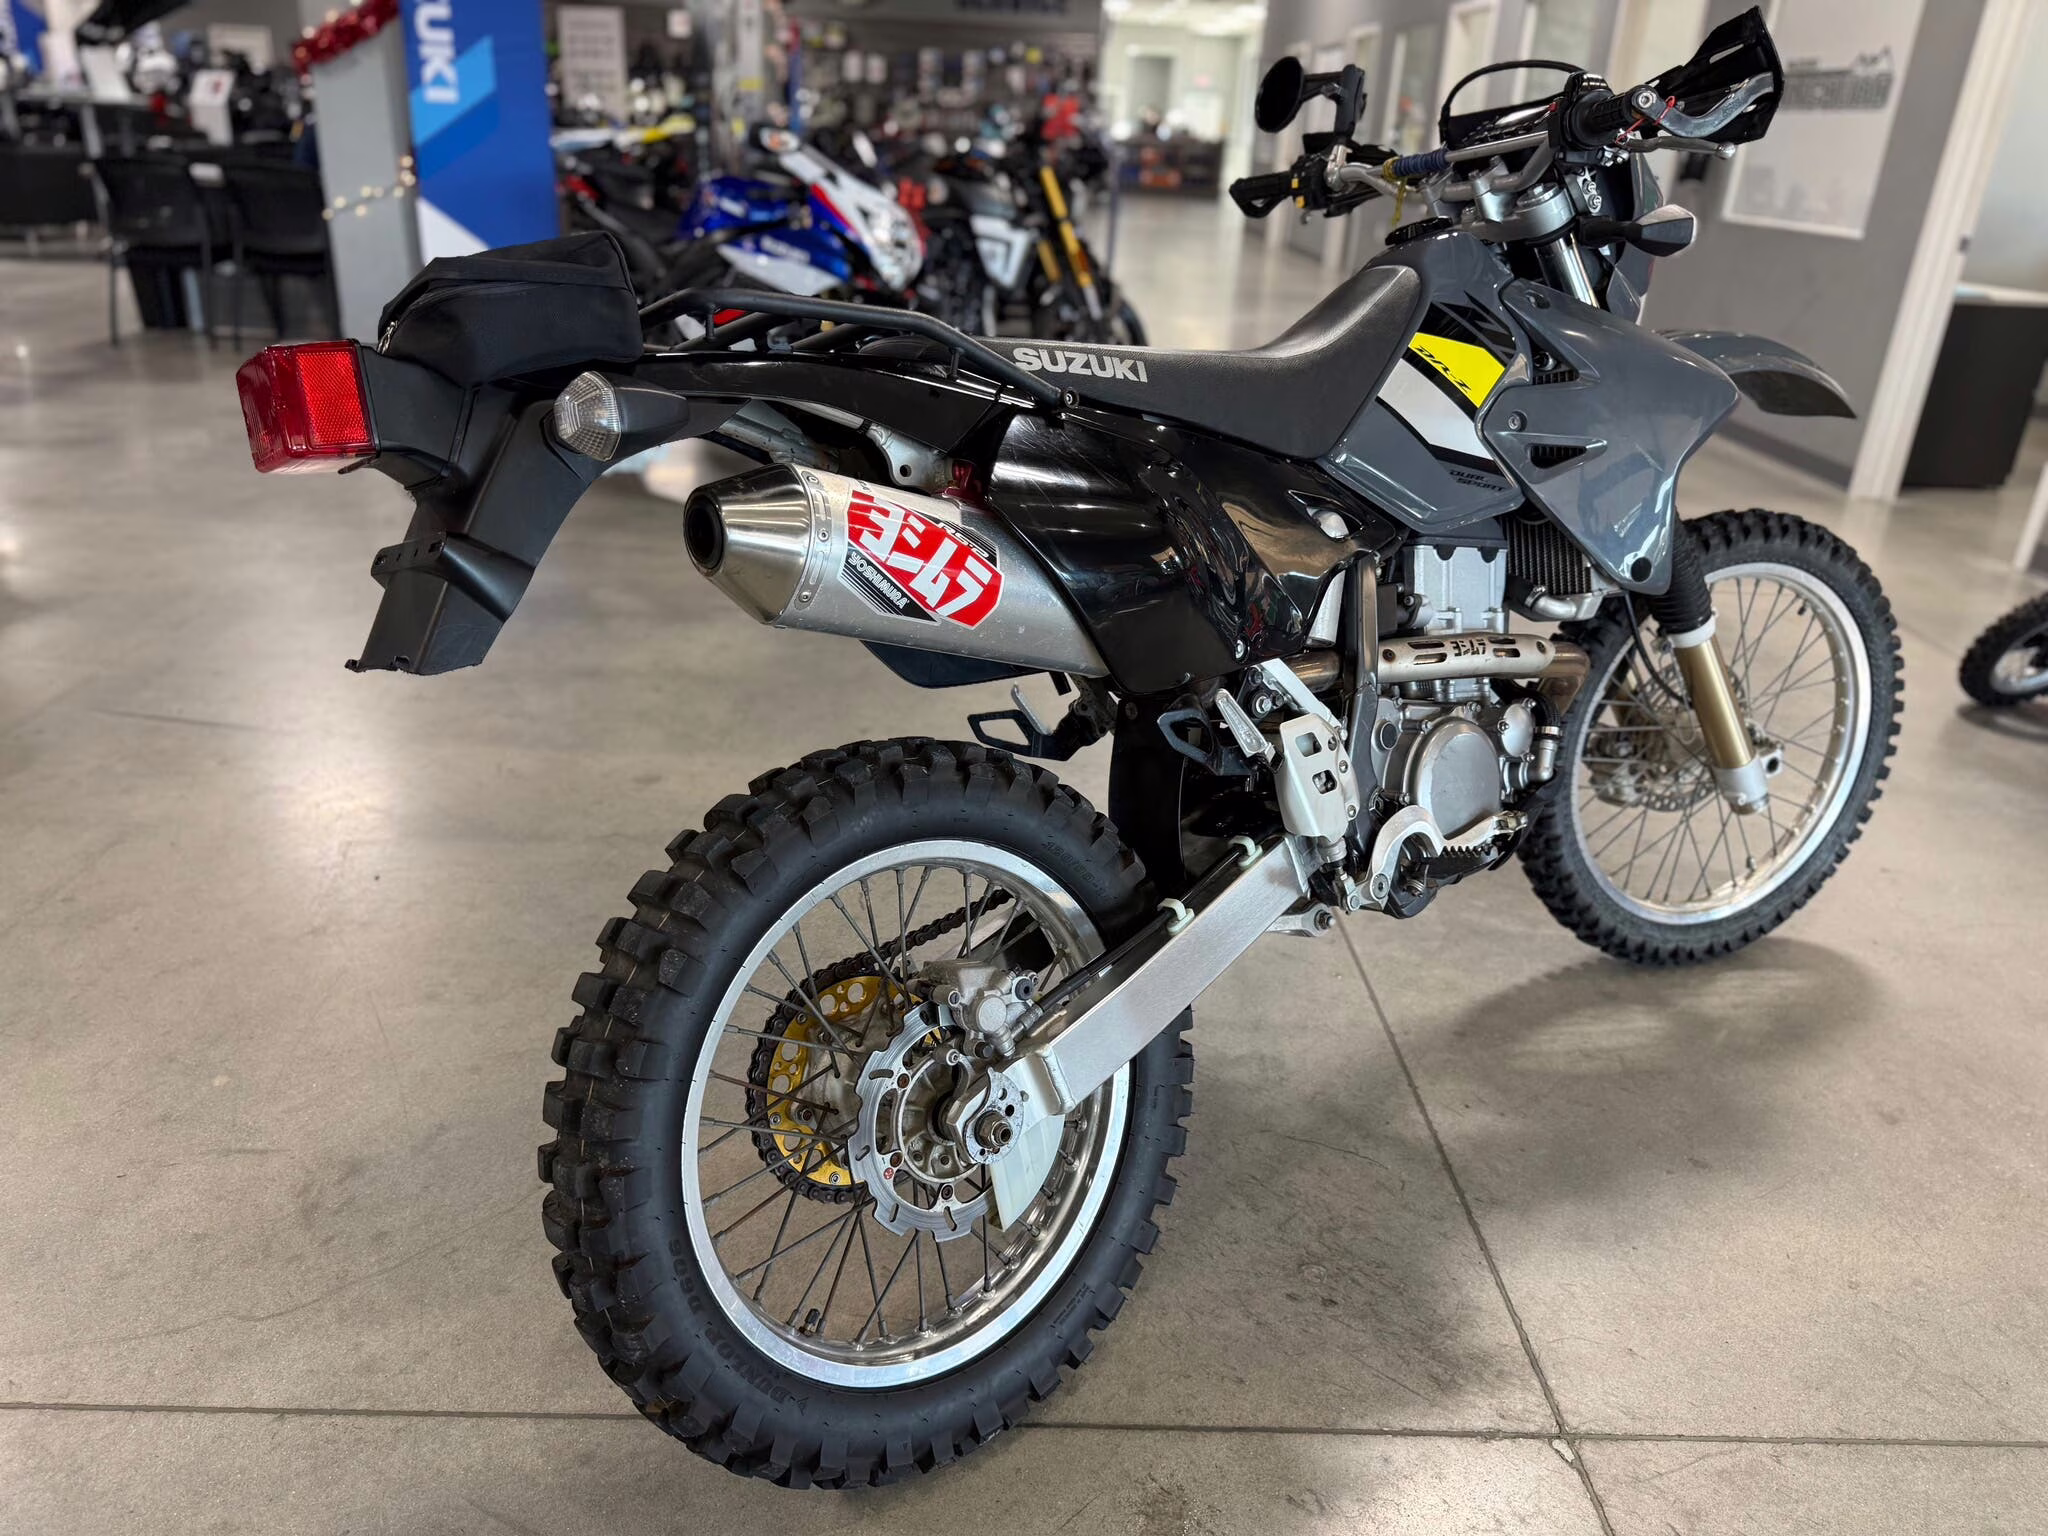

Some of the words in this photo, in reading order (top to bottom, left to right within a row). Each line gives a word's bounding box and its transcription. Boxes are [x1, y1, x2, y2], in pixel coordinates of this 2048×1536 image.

[1012, 347, 1148, 383] SUZUKI
[1455, 477, 1507, 492] SPORT
[847, 551, 908, 609] YOSHIMURA
